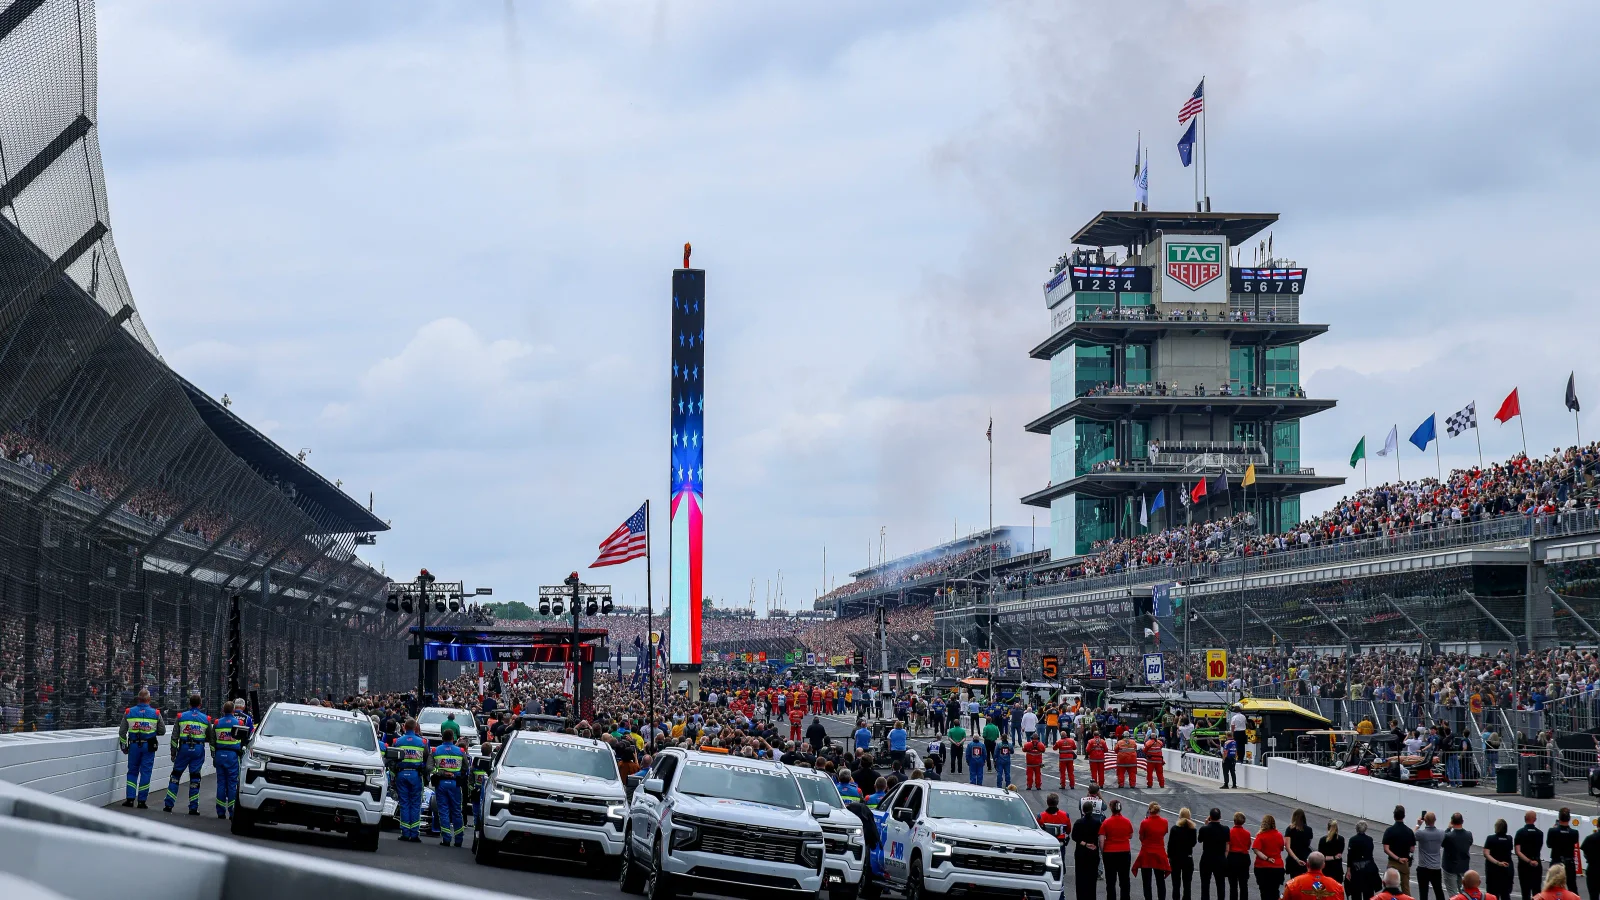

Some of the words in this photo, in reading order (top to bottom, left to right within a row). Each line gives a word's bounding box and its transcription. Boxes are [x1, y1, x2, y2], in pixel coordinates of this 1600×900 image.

[1171, 246, 1216, 261] TAG
[1170, 263, 1218, 288] HEUER
[1077, 279, 1083, 290] 1
[1092, 279, 1100, 290] 2
[1108, 279, 1116, 290] 3
[1123, 280, 1132, 290] 4
[1243, 281, 1252, 292] 5
[1259, 281, 1268, 292] 6
[1275, 281, 1283, 292] 7
[1291, 281, 1299, 292] 8
[922, 658, 931, 667] 75
[949, 655, 956, 667] 9
[1042, 657, 1058, 677] 5
[1147, 663, 1161, 674] 60
[1092, 664, 1103, 675] 14
[1208, 660, 1225, 678] 10
[282, 709, 361, 725] CHEVROLET
[524, 739, 601, 754] CHEVROLET
[686, 760, 790, 779] CHEVROLET
[939, 789, 1014, 802] CHEVROLET
[889, 840, 904, 860] AMR
